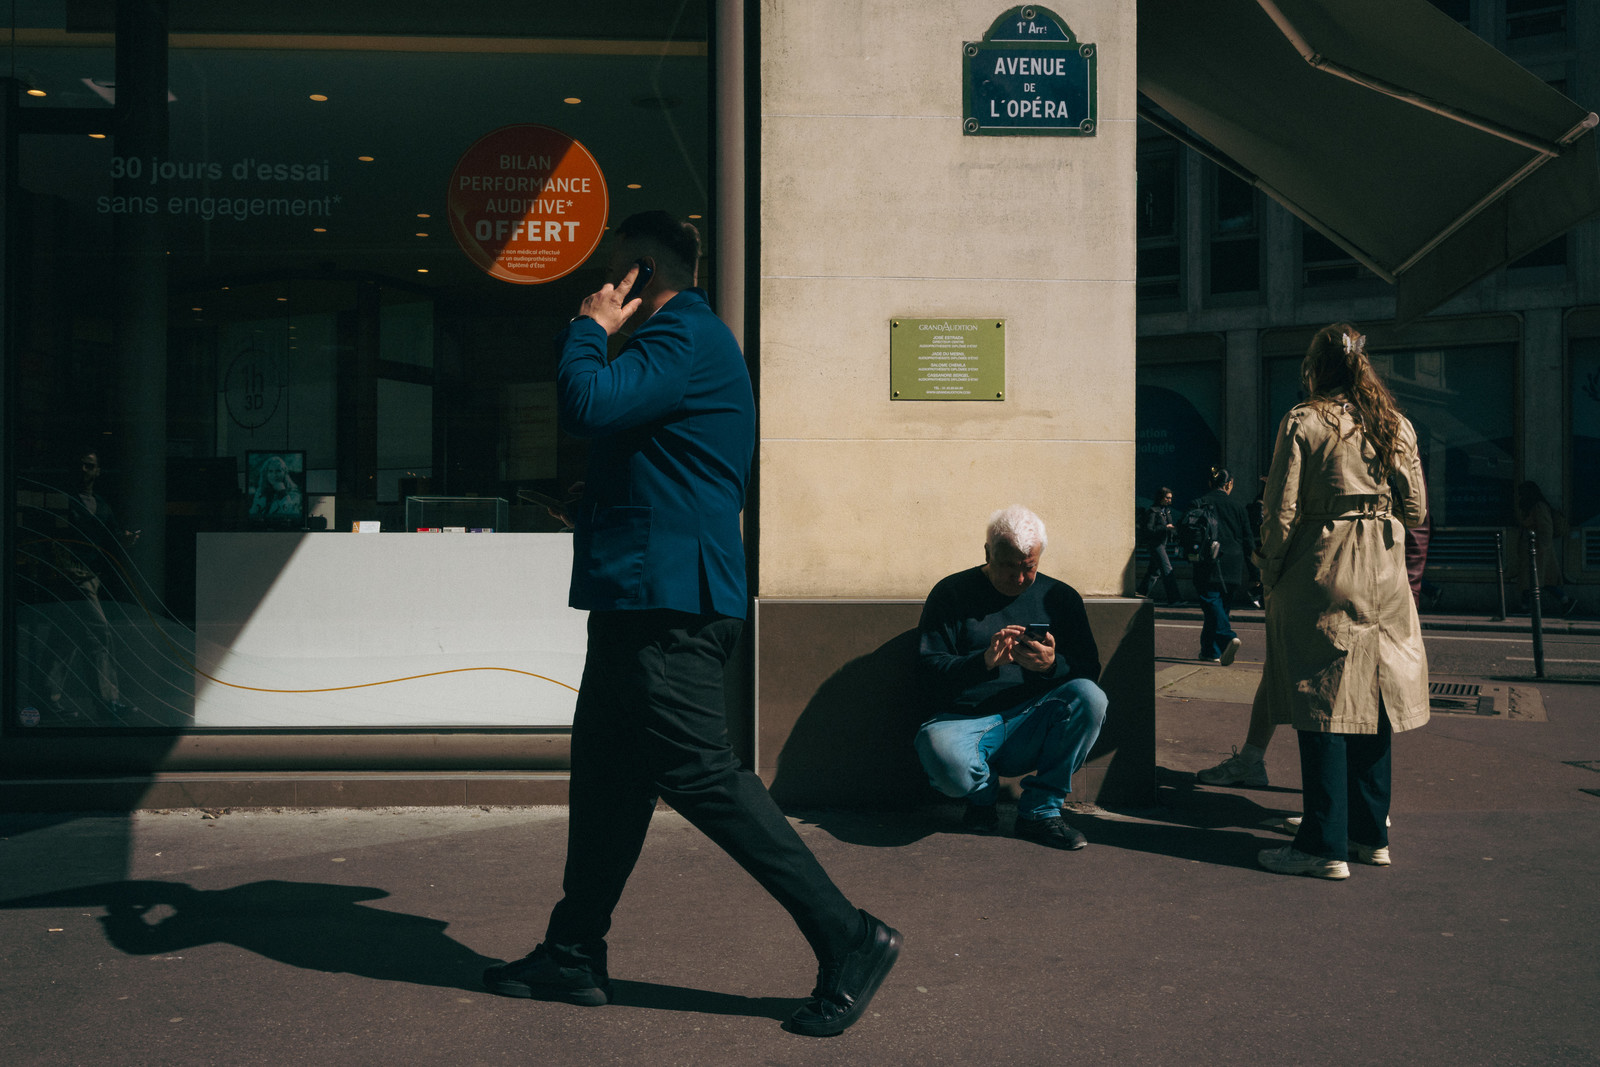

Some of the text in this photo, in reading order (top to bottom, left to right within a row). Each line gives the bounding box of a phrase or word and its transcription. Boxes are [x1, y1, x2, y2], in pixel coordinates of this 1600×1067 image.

[994, 57, 1066, 76] AVENUE
[1024, 83, 1036, 93] DE
[990, 96, 1068, 118] L'OPÉRA
[110, 156, 330, 184] 30 jours d'essai
[500, 155, 552, 170] BILAN
[460, 176, 591, 193] PERFORMANCE
[96, 195, 158, 214] sans
[476, 220, 580, 242] OFFERT
[244, 394, 264, 411] 3D
[1138, 428, 1167, 438] ation
